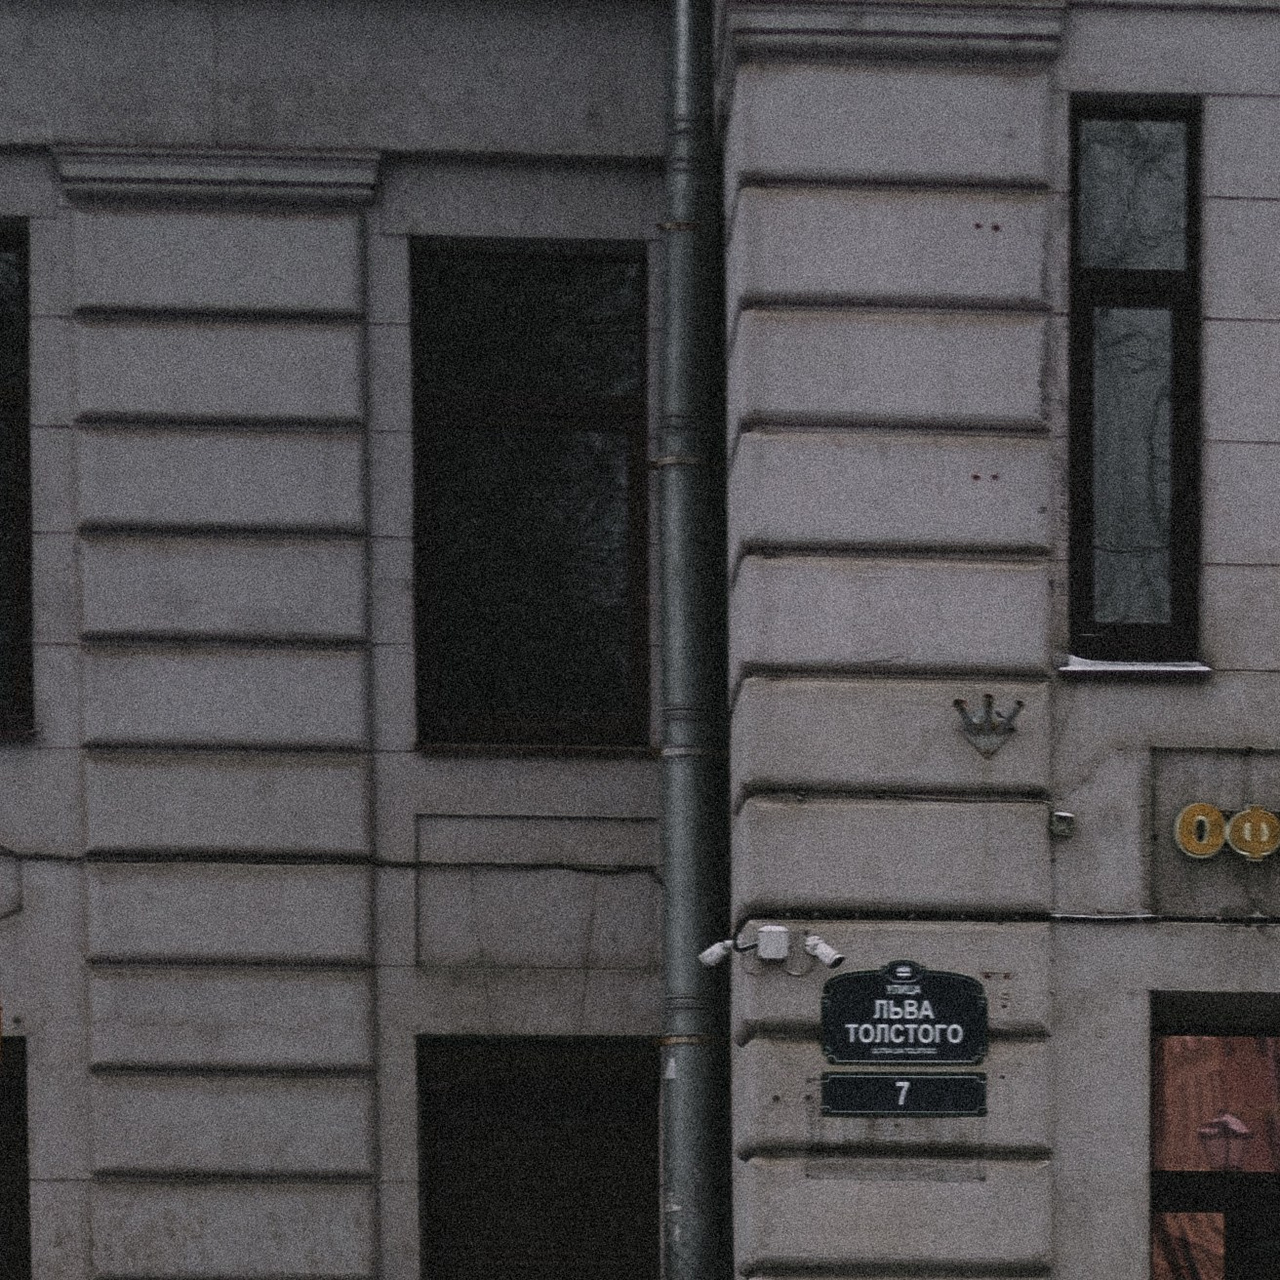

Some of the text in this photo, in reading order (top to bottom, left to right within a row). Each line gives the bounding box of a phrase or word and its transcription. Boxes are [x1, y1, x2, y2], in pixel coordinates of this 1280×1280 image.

[873, 1000, 935, 1019] ЛЬВА
[845, 1024, 964, 1044] ТОЛСТОГО
[895, 1081, 911, 1105] 7
